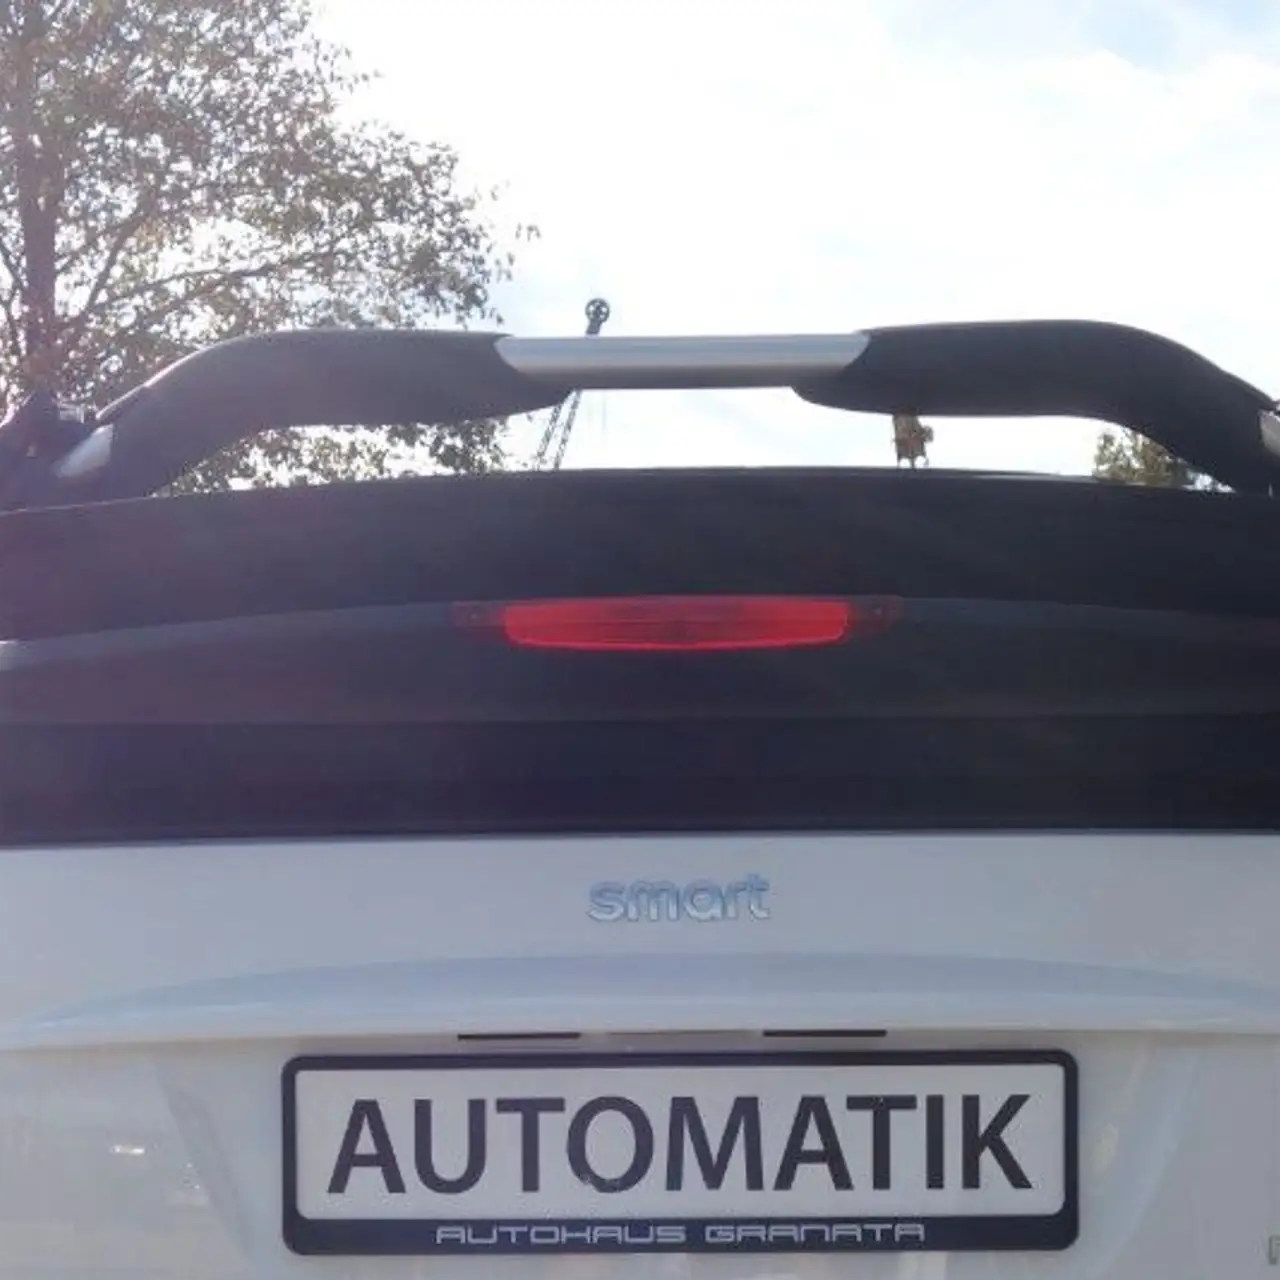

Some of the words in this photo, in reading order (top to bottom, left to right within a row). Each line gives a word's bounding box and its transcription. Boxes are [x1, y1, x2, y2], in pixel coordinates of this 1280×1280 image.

[587, 873, 770, 922] smart
[326, 1093, 1033, 1194] AUTOMATIK
[436, 1225, 686, 1245] AUTOHAUS
[704, 1222, 925, 1243] GRANATA
